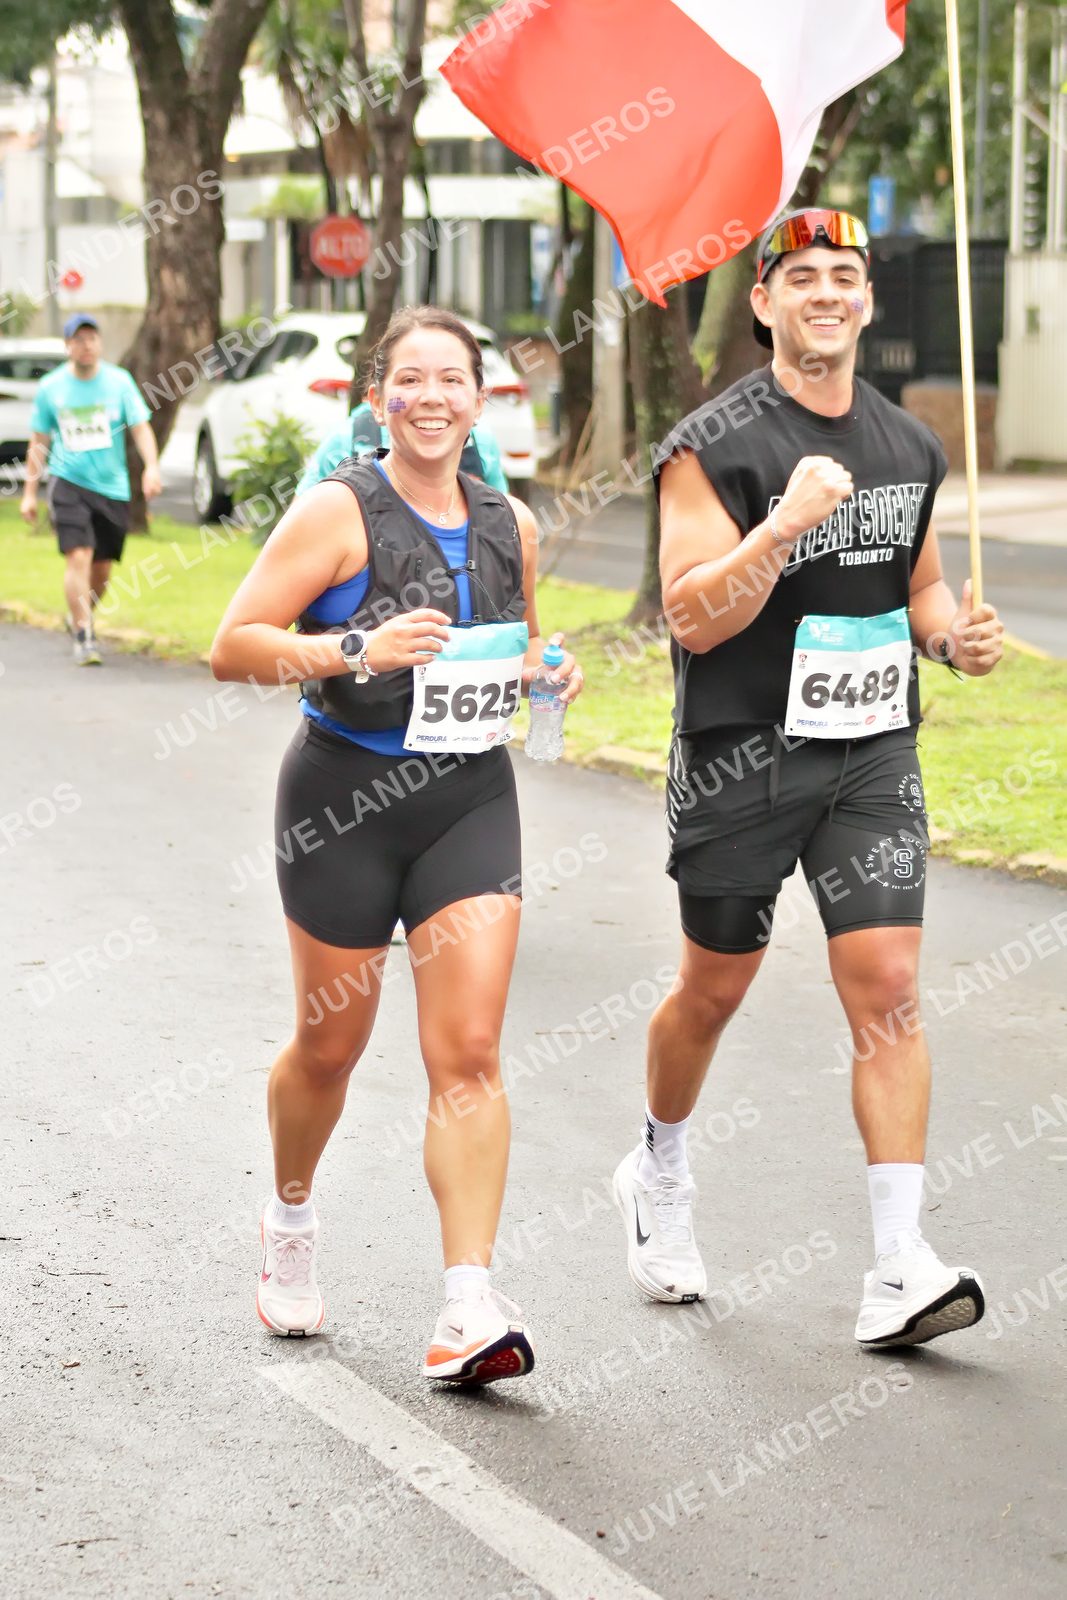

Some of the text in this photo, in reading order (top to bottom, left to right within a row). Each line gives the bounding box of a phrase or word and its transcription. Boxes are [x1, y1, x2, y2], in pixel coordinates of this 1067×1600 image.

[838, 548, 893, 567] TORONTO
[421, 679, 520, 723] 5625
[802, 664, 900, 709] 6489
[894, 848, 912, 878] S
